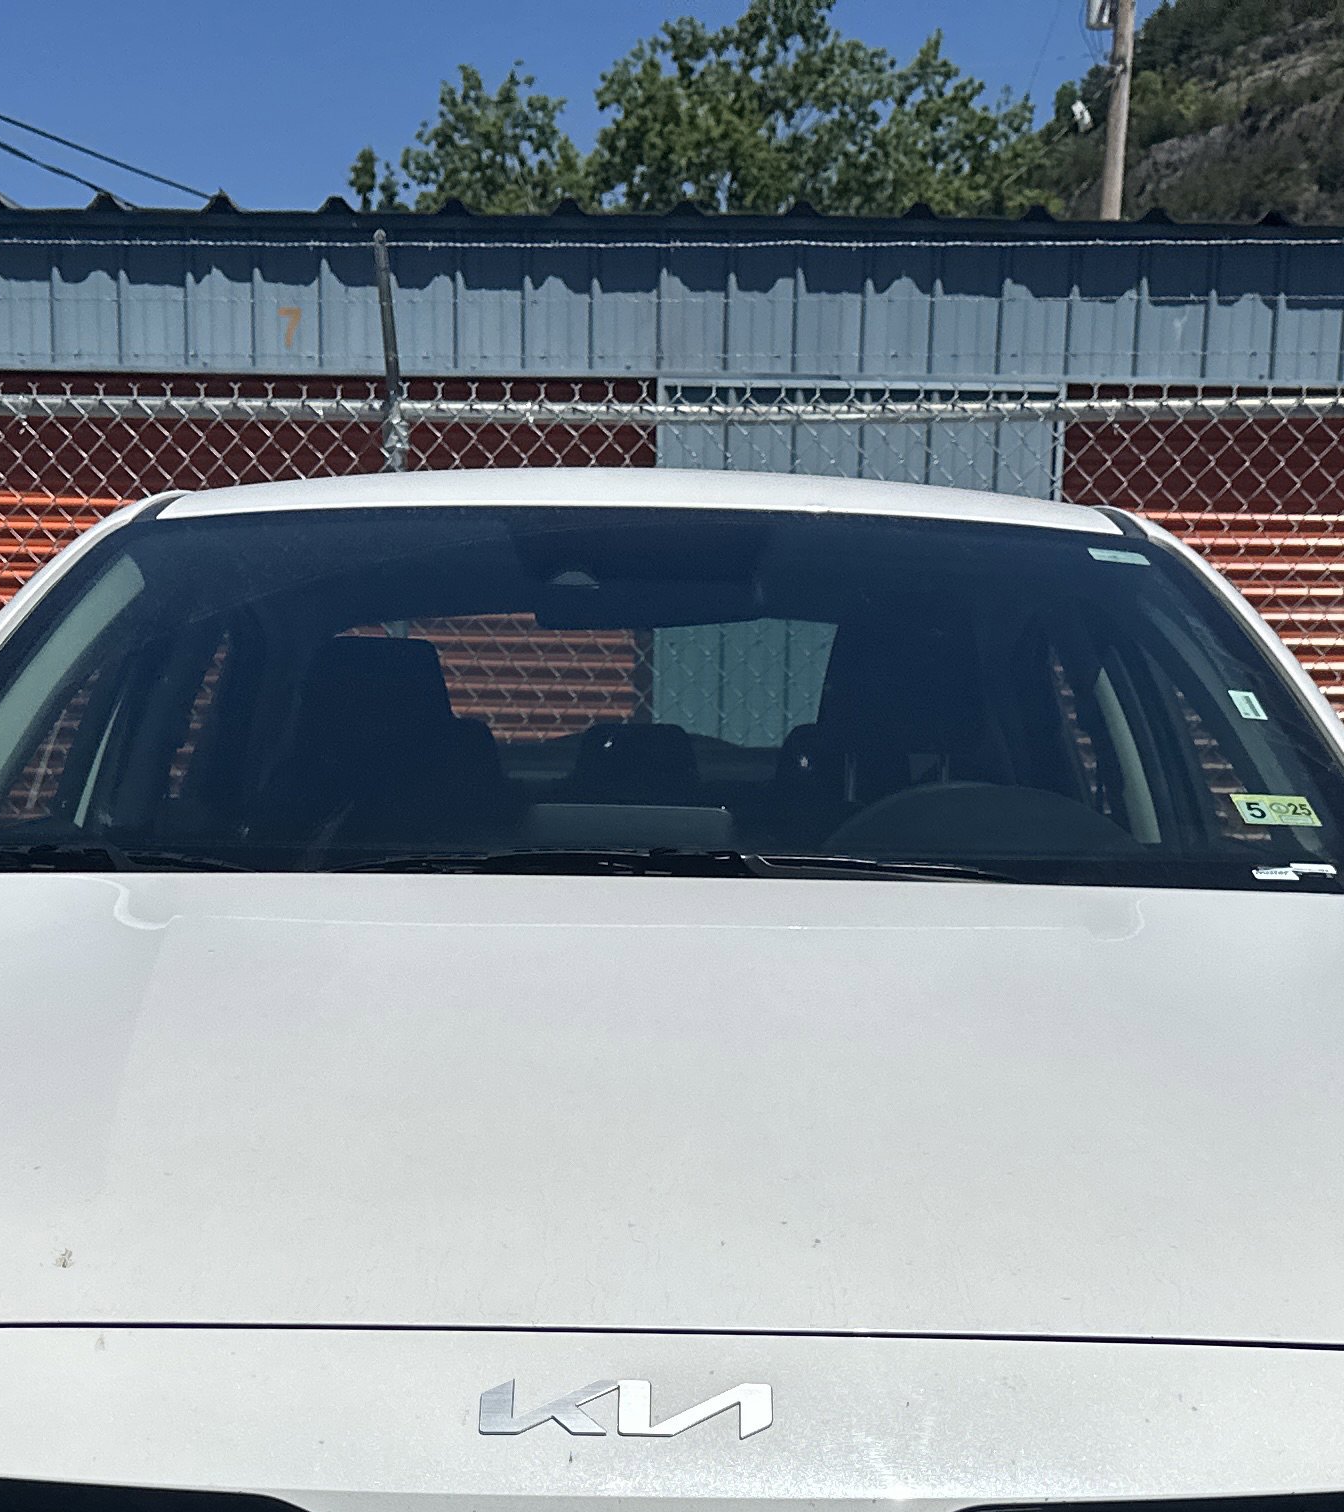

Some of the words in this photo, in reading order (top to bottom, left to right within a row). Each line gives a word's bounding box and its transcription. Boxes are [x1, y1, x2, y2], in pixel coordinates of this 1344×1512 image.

[277, 307, 302, 349] 7
[1245, 802, 1267, 819] 5
[1287, 803, 1312, 816] 25
